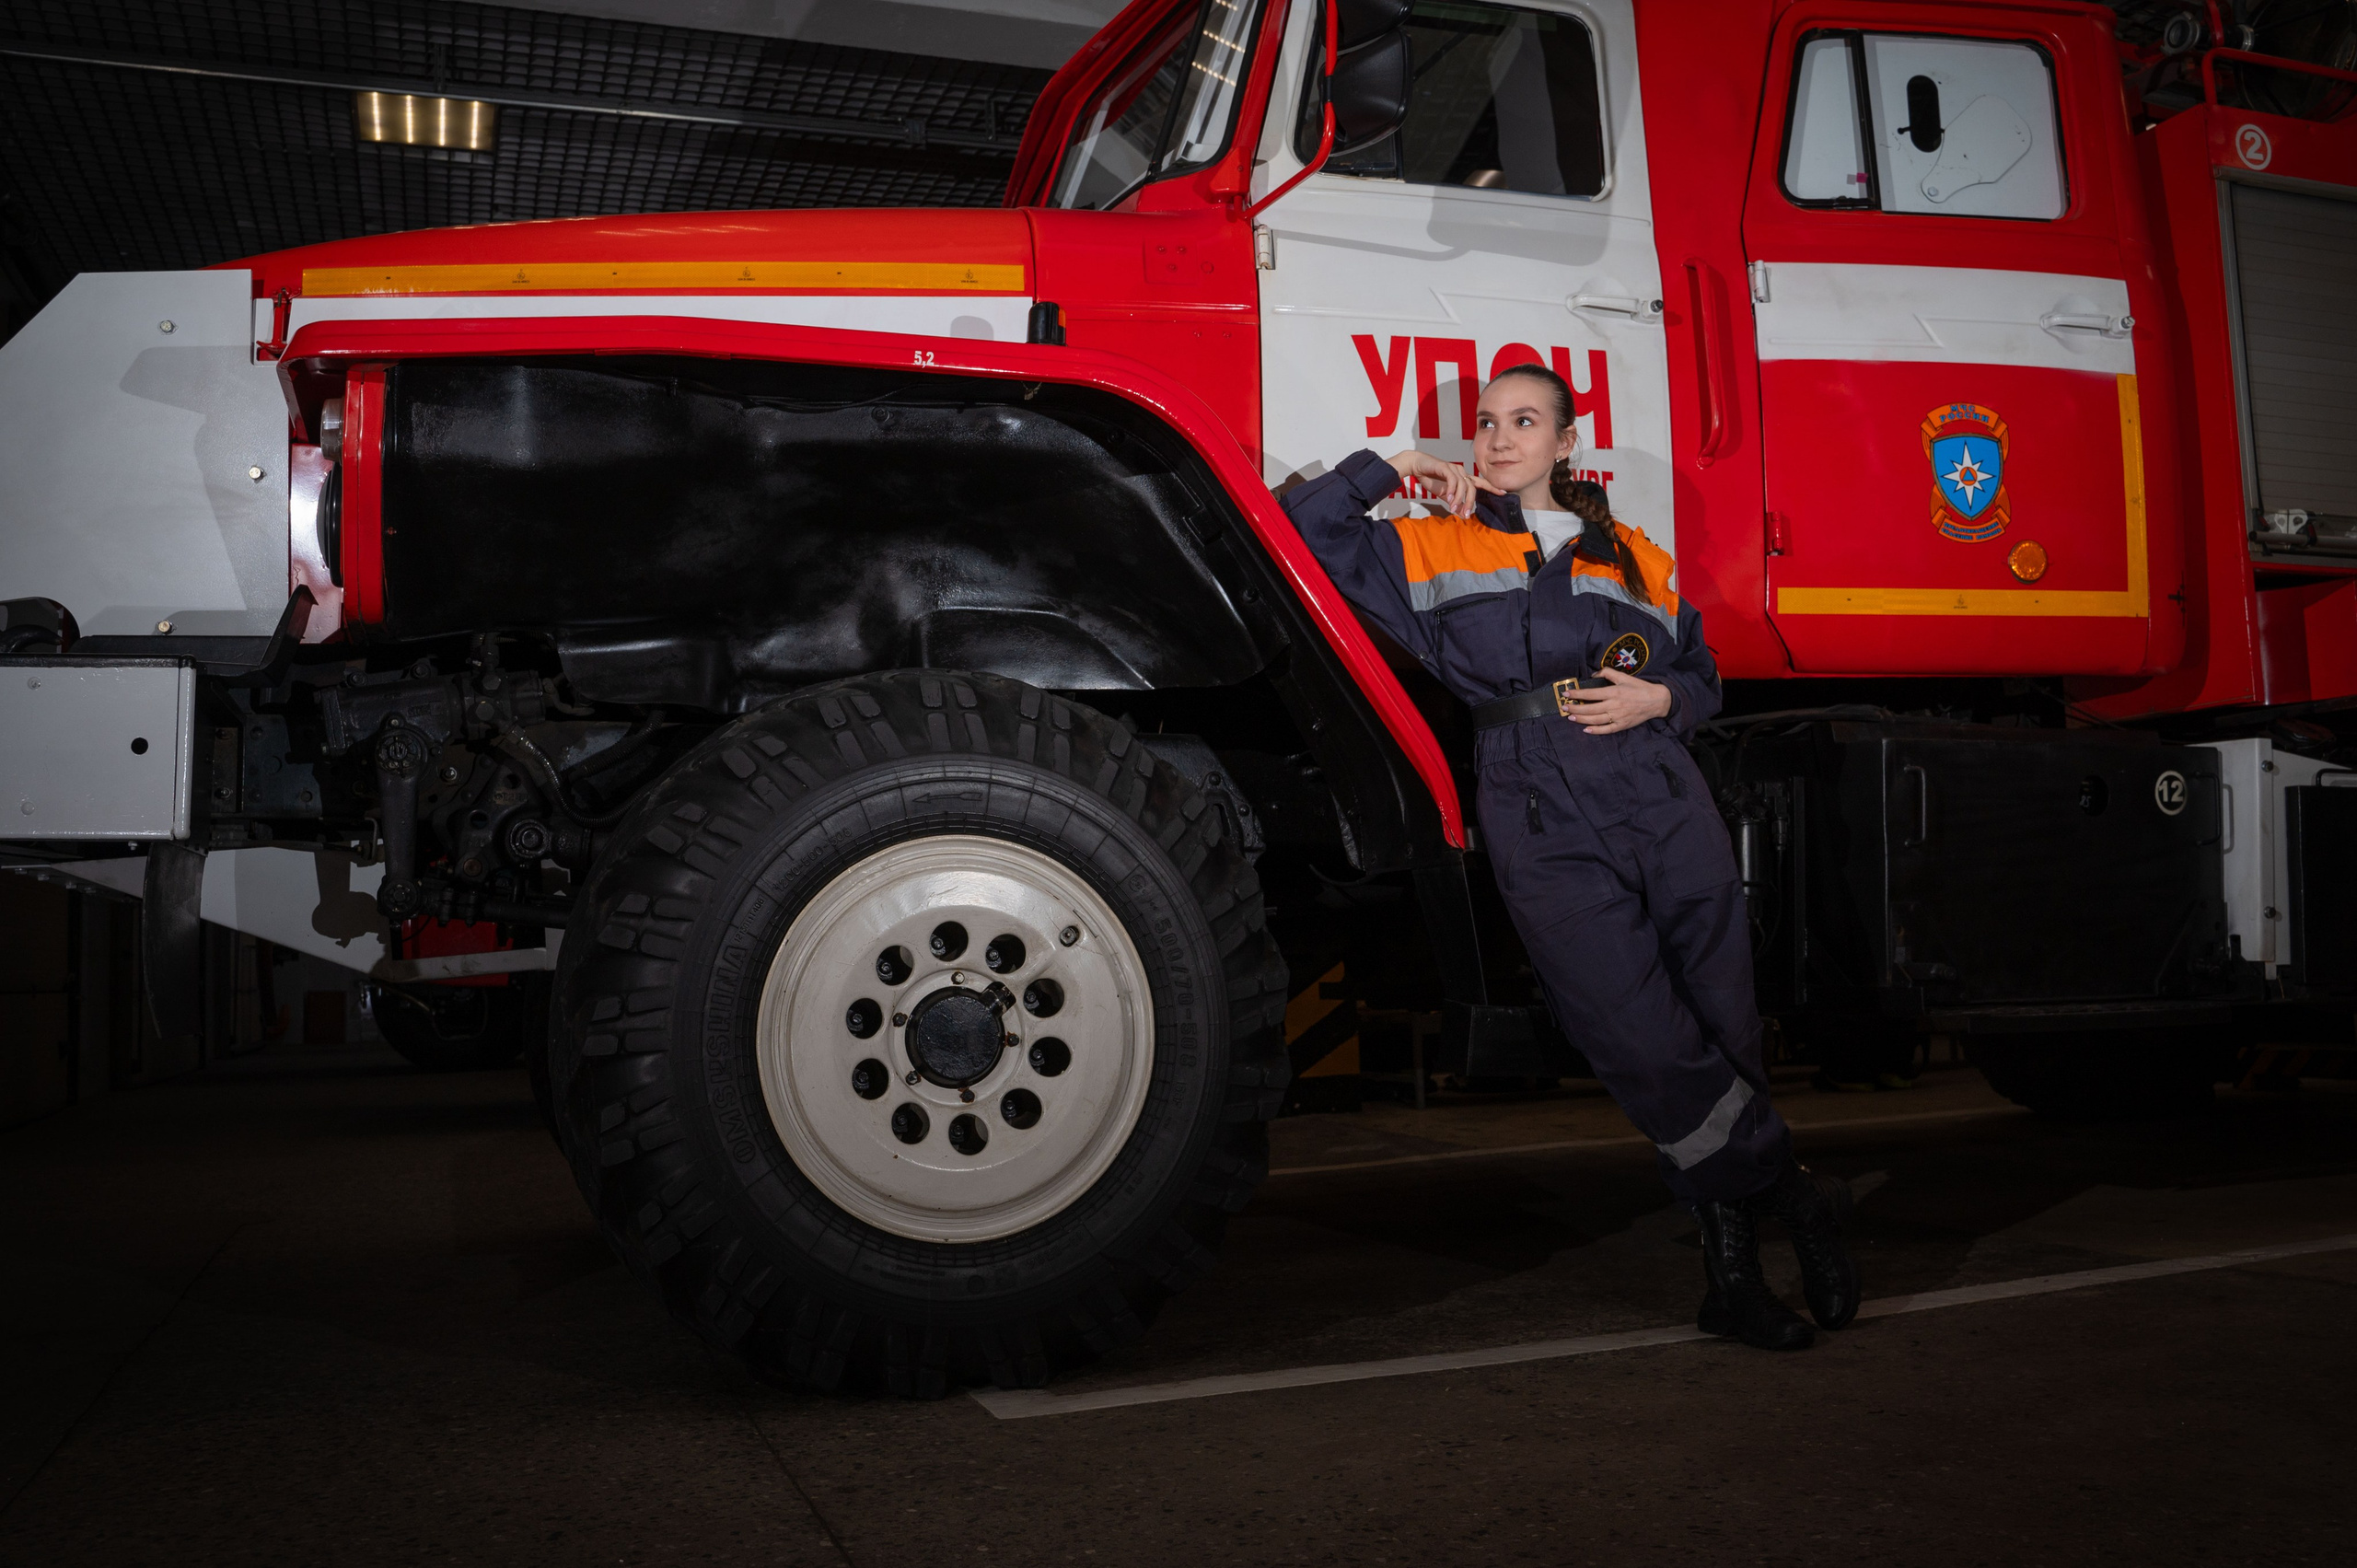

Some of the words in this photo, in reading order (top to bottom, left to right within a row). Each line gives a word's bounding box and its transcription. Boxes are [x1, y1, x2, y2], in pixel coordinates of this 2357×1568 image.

[2244, 131, 2263, 160] 2
[914, 350, 935, 368] 5,2
[1939, 412, 1990, 423] РОССИИ
[1950, 404, 1976, 412] МЧС
[2158, 780, 2184, 802] 12
[706, 945, 757, 1164] OMSKSHINA
